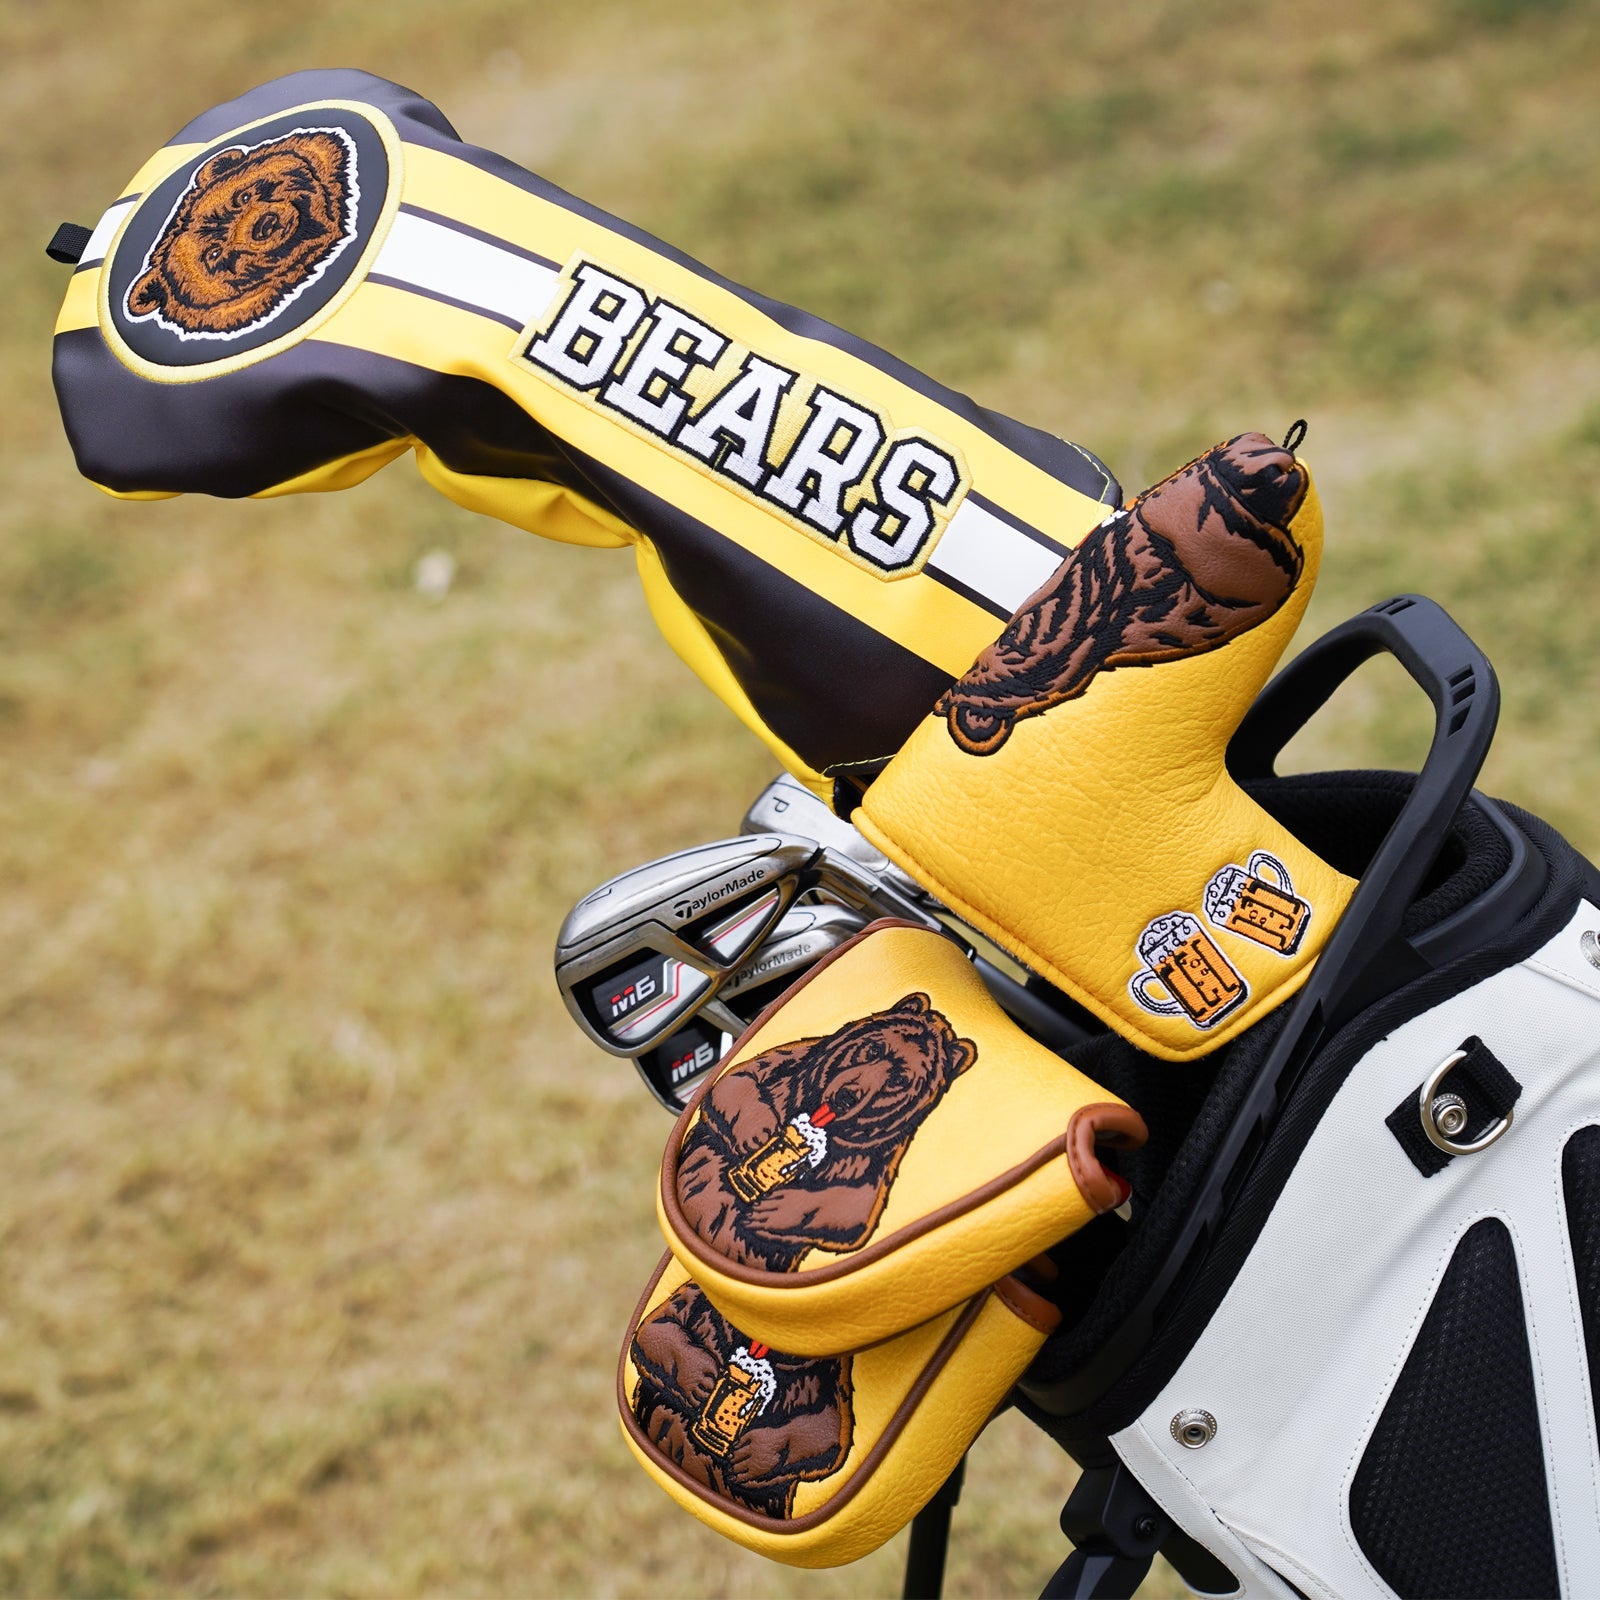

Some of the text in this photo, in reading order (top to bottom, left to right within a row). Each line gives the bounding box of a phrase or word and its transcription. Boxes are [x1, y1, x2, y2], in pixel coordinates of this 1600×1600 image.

[522, 260, 961, 571] BEARS
[772, 796, 790, 813] P
[673, 869, 764, 919] TaylorMade
[610, 975, 656, 1017] M6
[671, 1042, 714, 1083] M6
